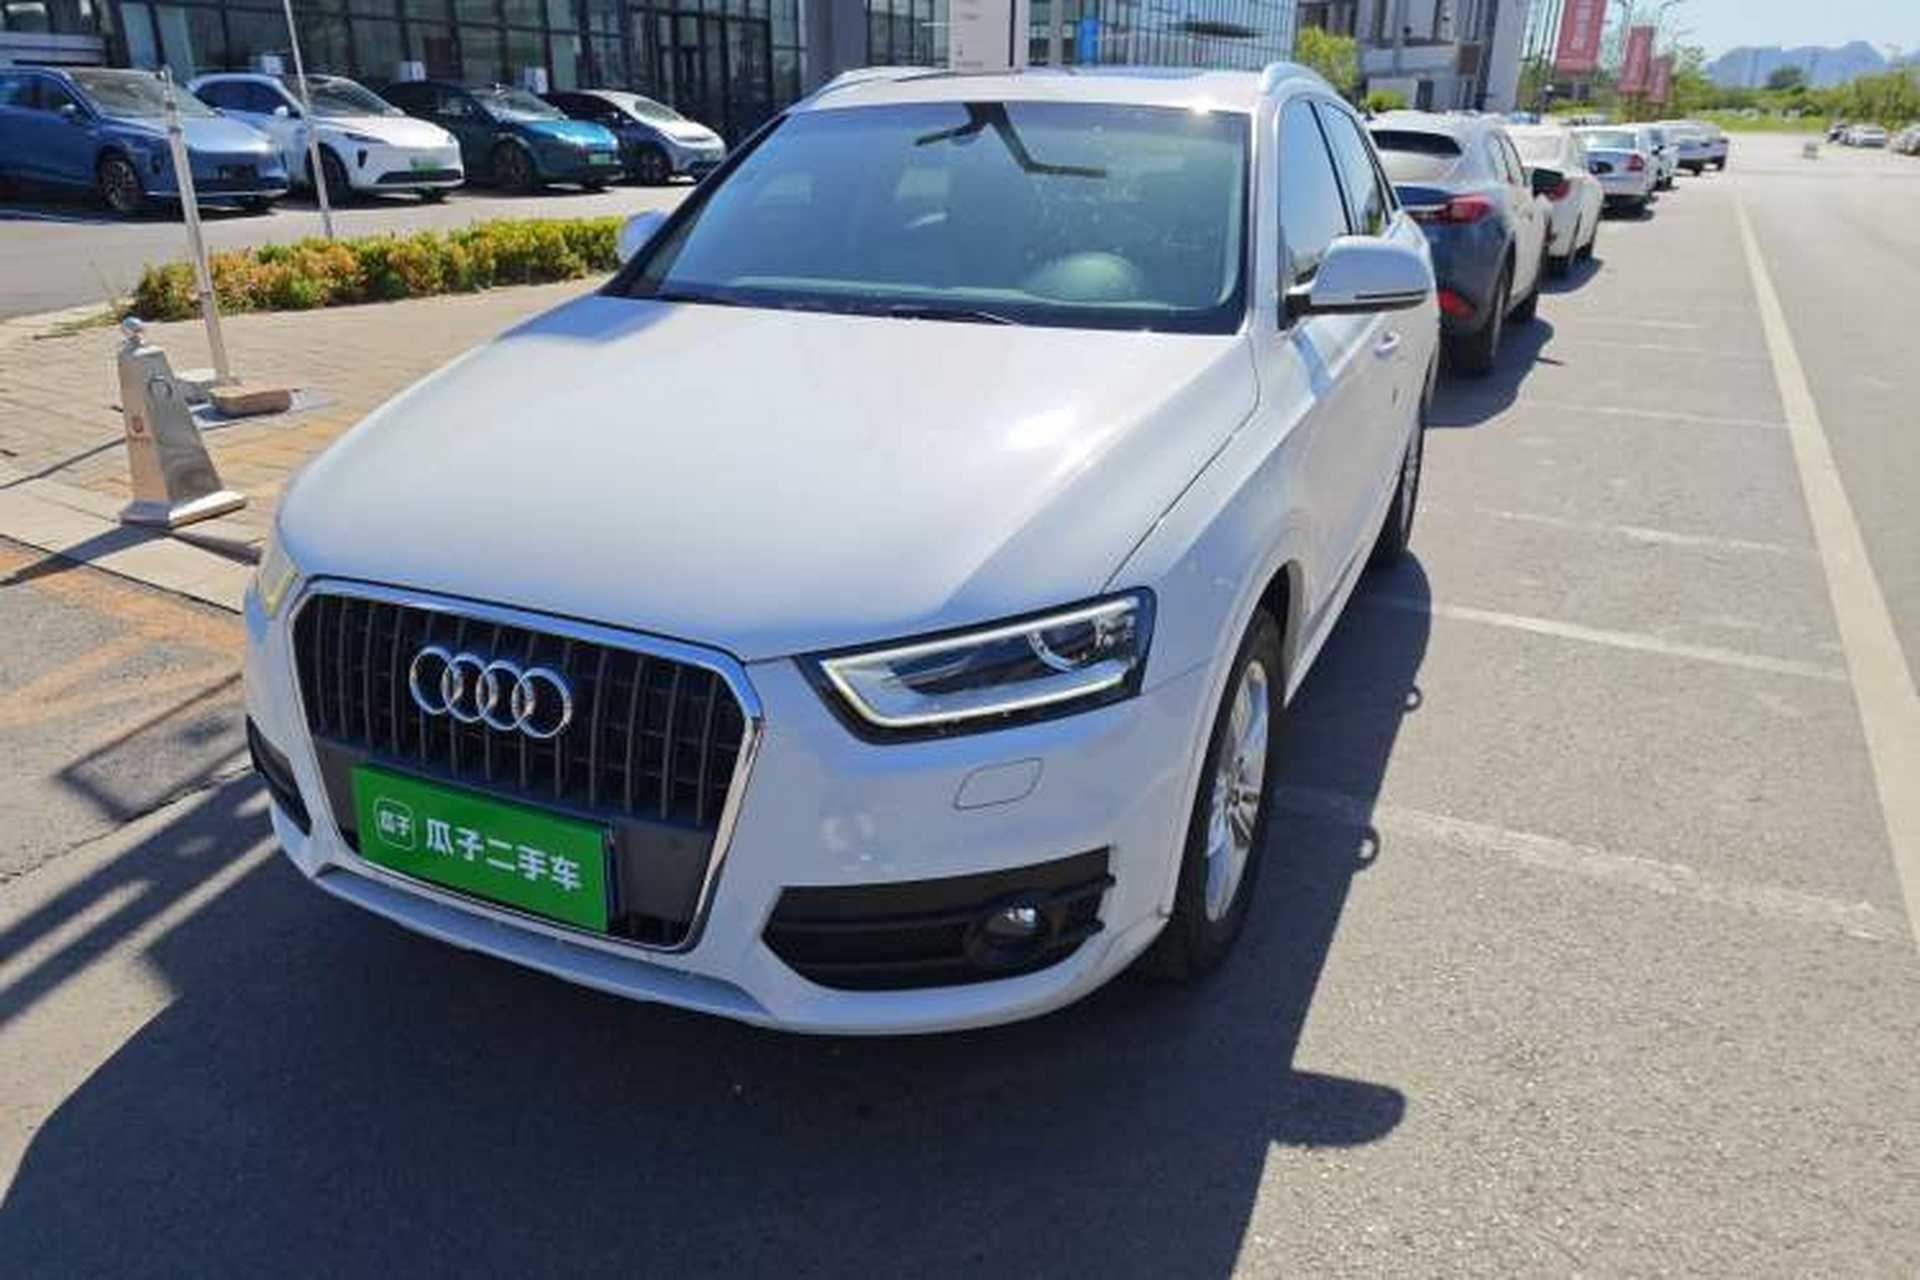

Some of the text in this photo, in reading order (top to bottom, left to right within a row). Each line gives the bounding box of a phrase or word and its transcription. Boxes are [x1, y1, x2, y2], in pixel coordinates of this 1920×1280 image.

[426, 817, 583, 891] 瓜子二手车
